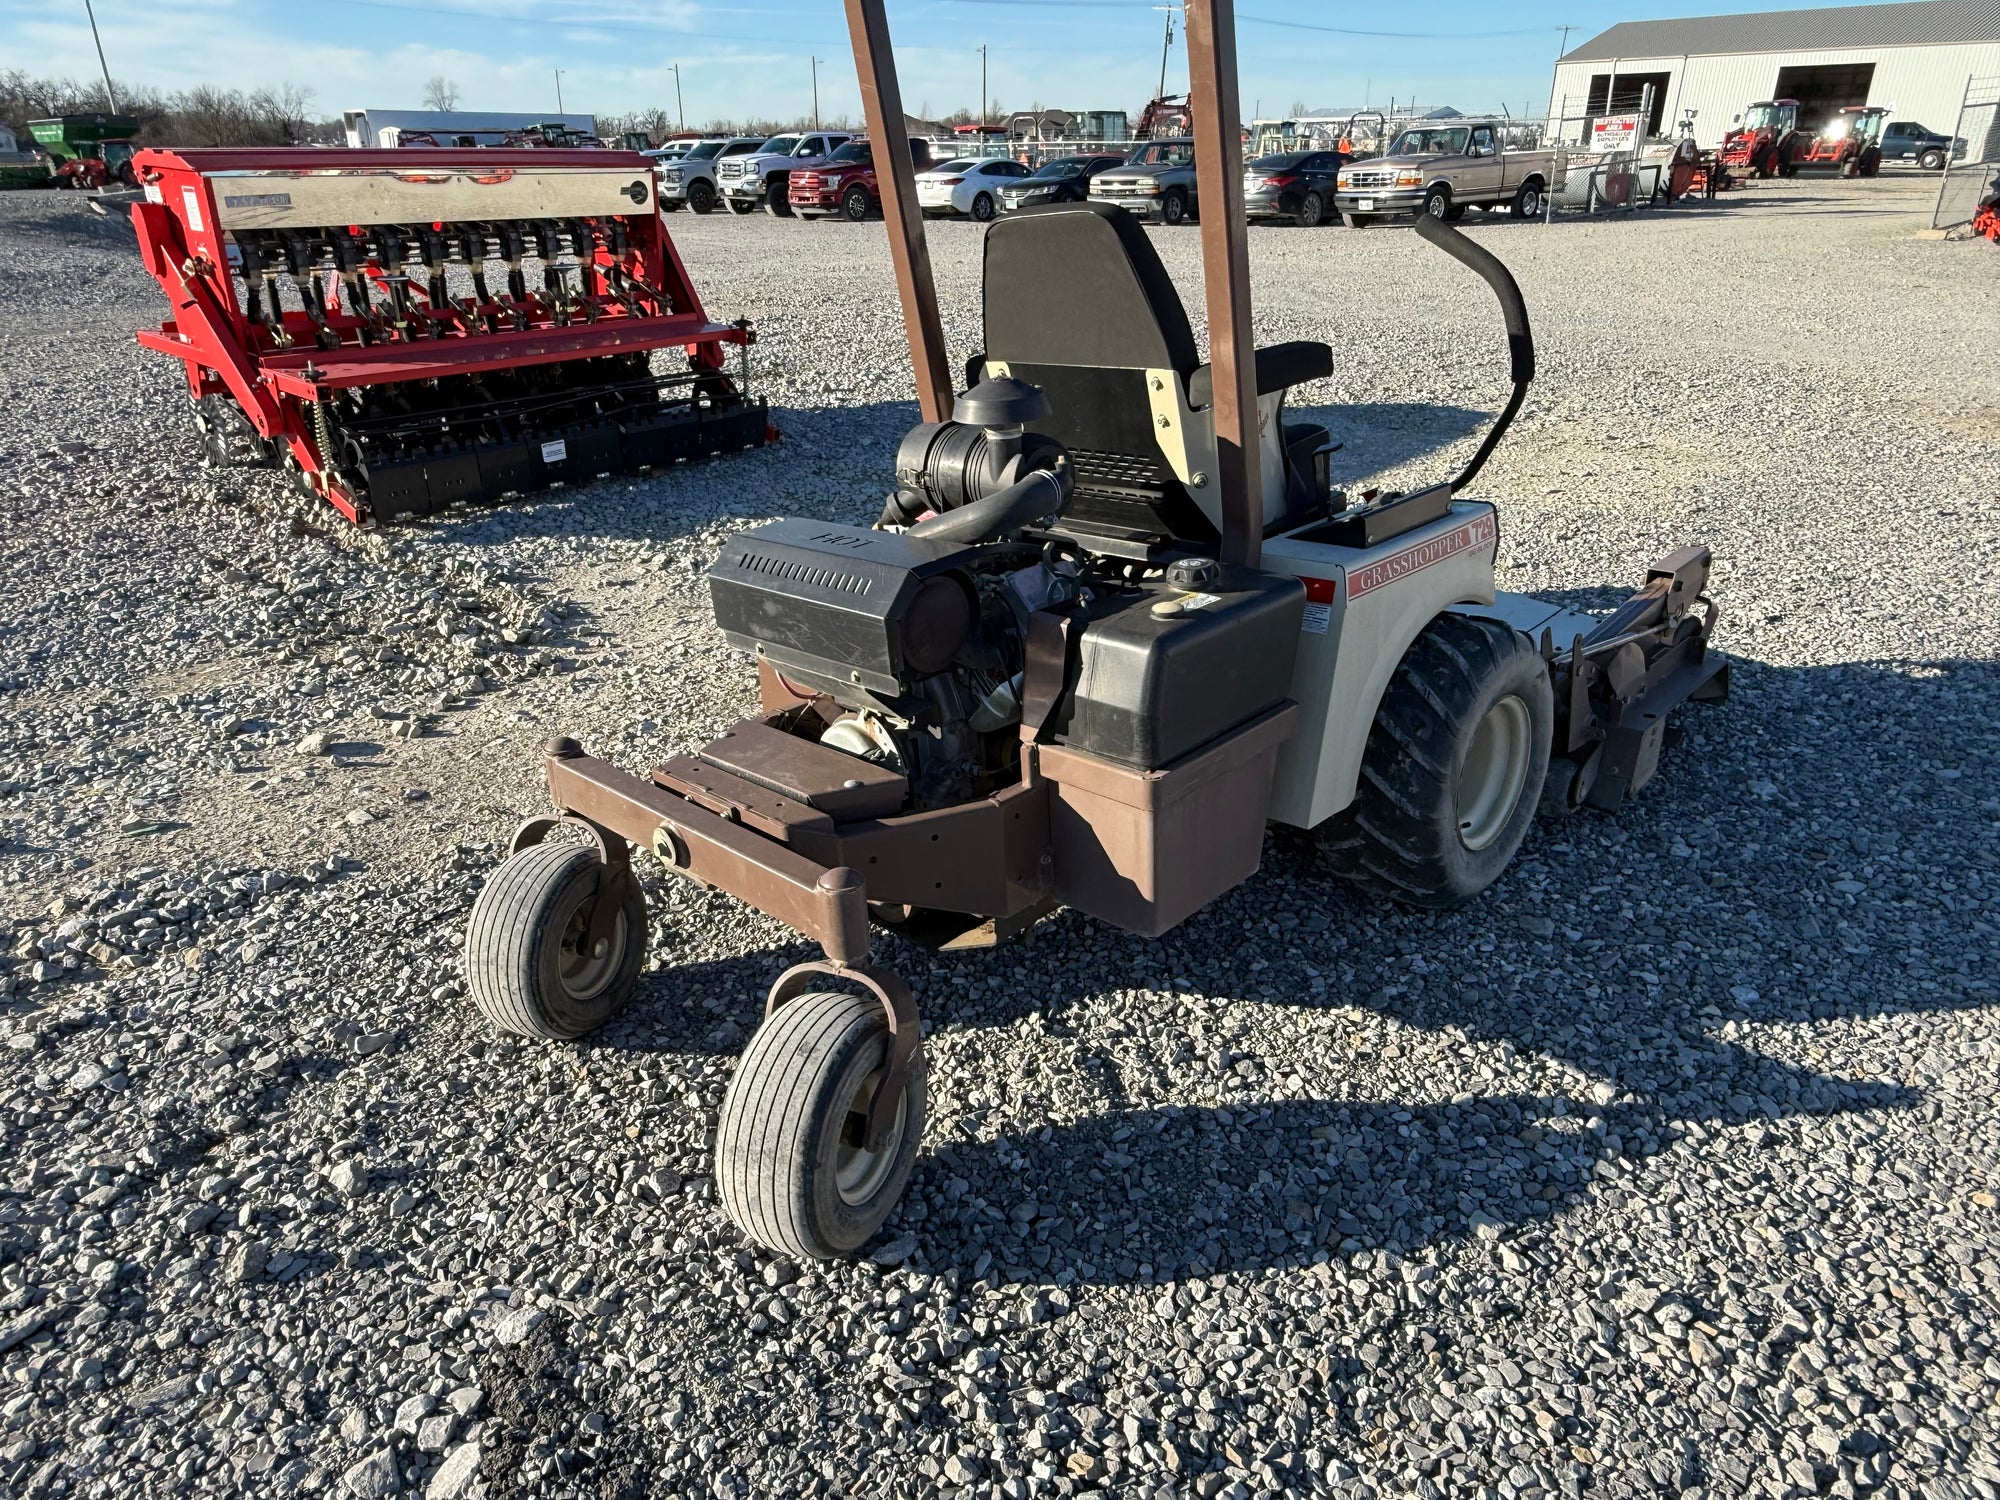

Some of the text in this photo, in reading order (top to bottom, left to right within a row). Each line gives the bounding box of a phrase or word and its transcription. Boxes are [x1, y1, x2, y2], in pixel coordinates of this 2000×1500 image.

[1603, 142, 1621, 150] ONLY
[809, 532, 880, 549] HOT
[1360, 516, 1494, 590] GRASSHOPPER 729
